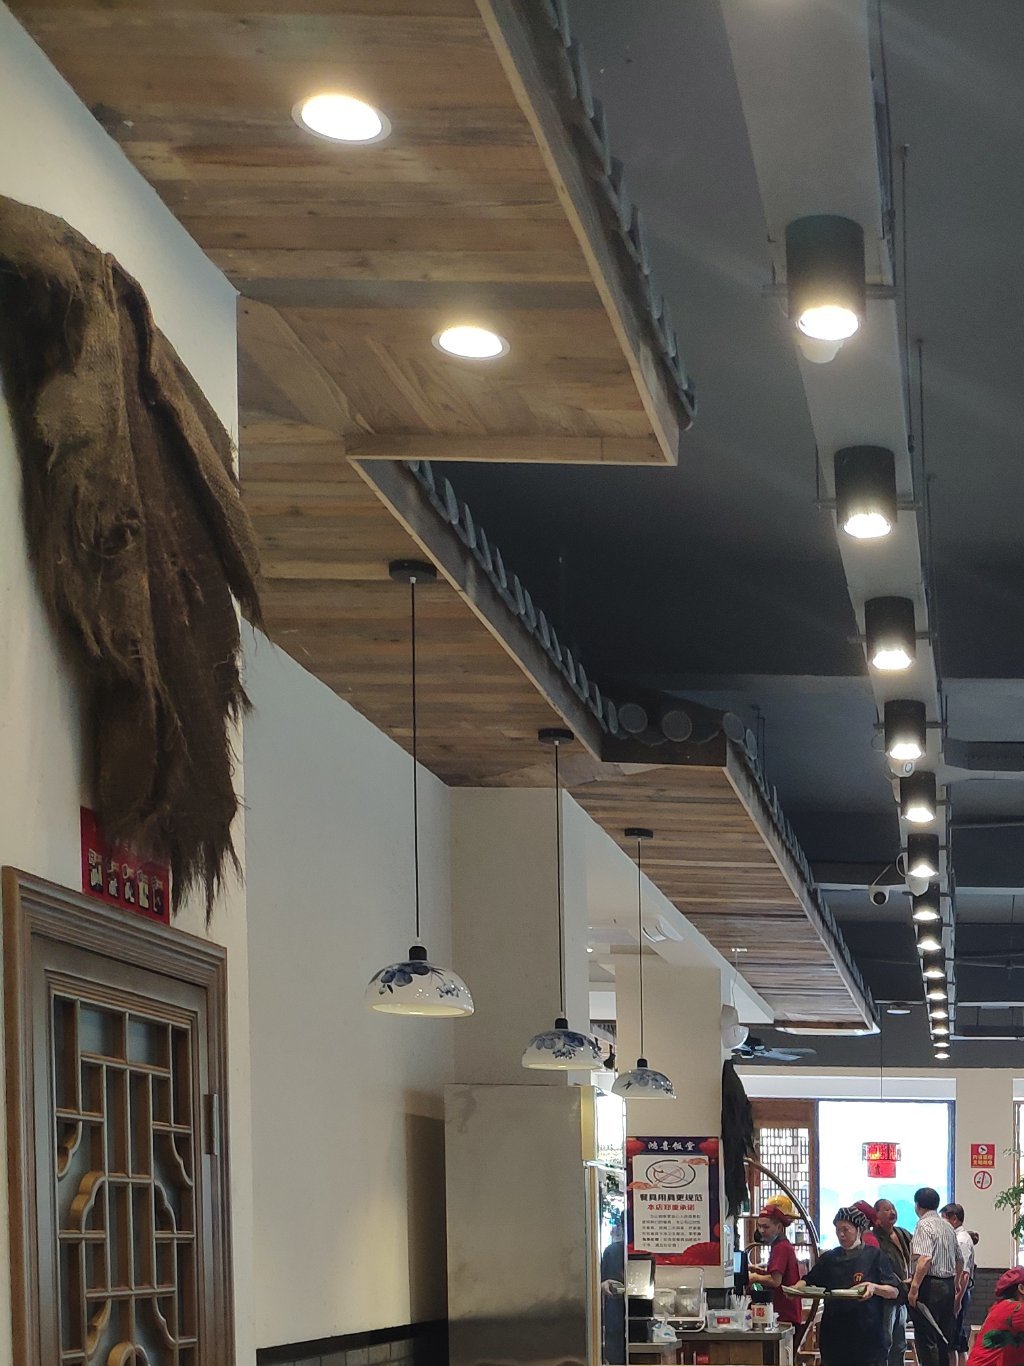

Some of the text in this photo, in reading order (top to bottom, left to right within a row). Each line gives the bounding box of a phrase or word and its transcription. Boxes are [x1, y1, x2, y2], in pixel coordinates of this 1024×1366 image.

[640, 1193, 703, 1202] 餐具用具更规范
[648, 1203, 695, 1211] 本店郑重承诺
